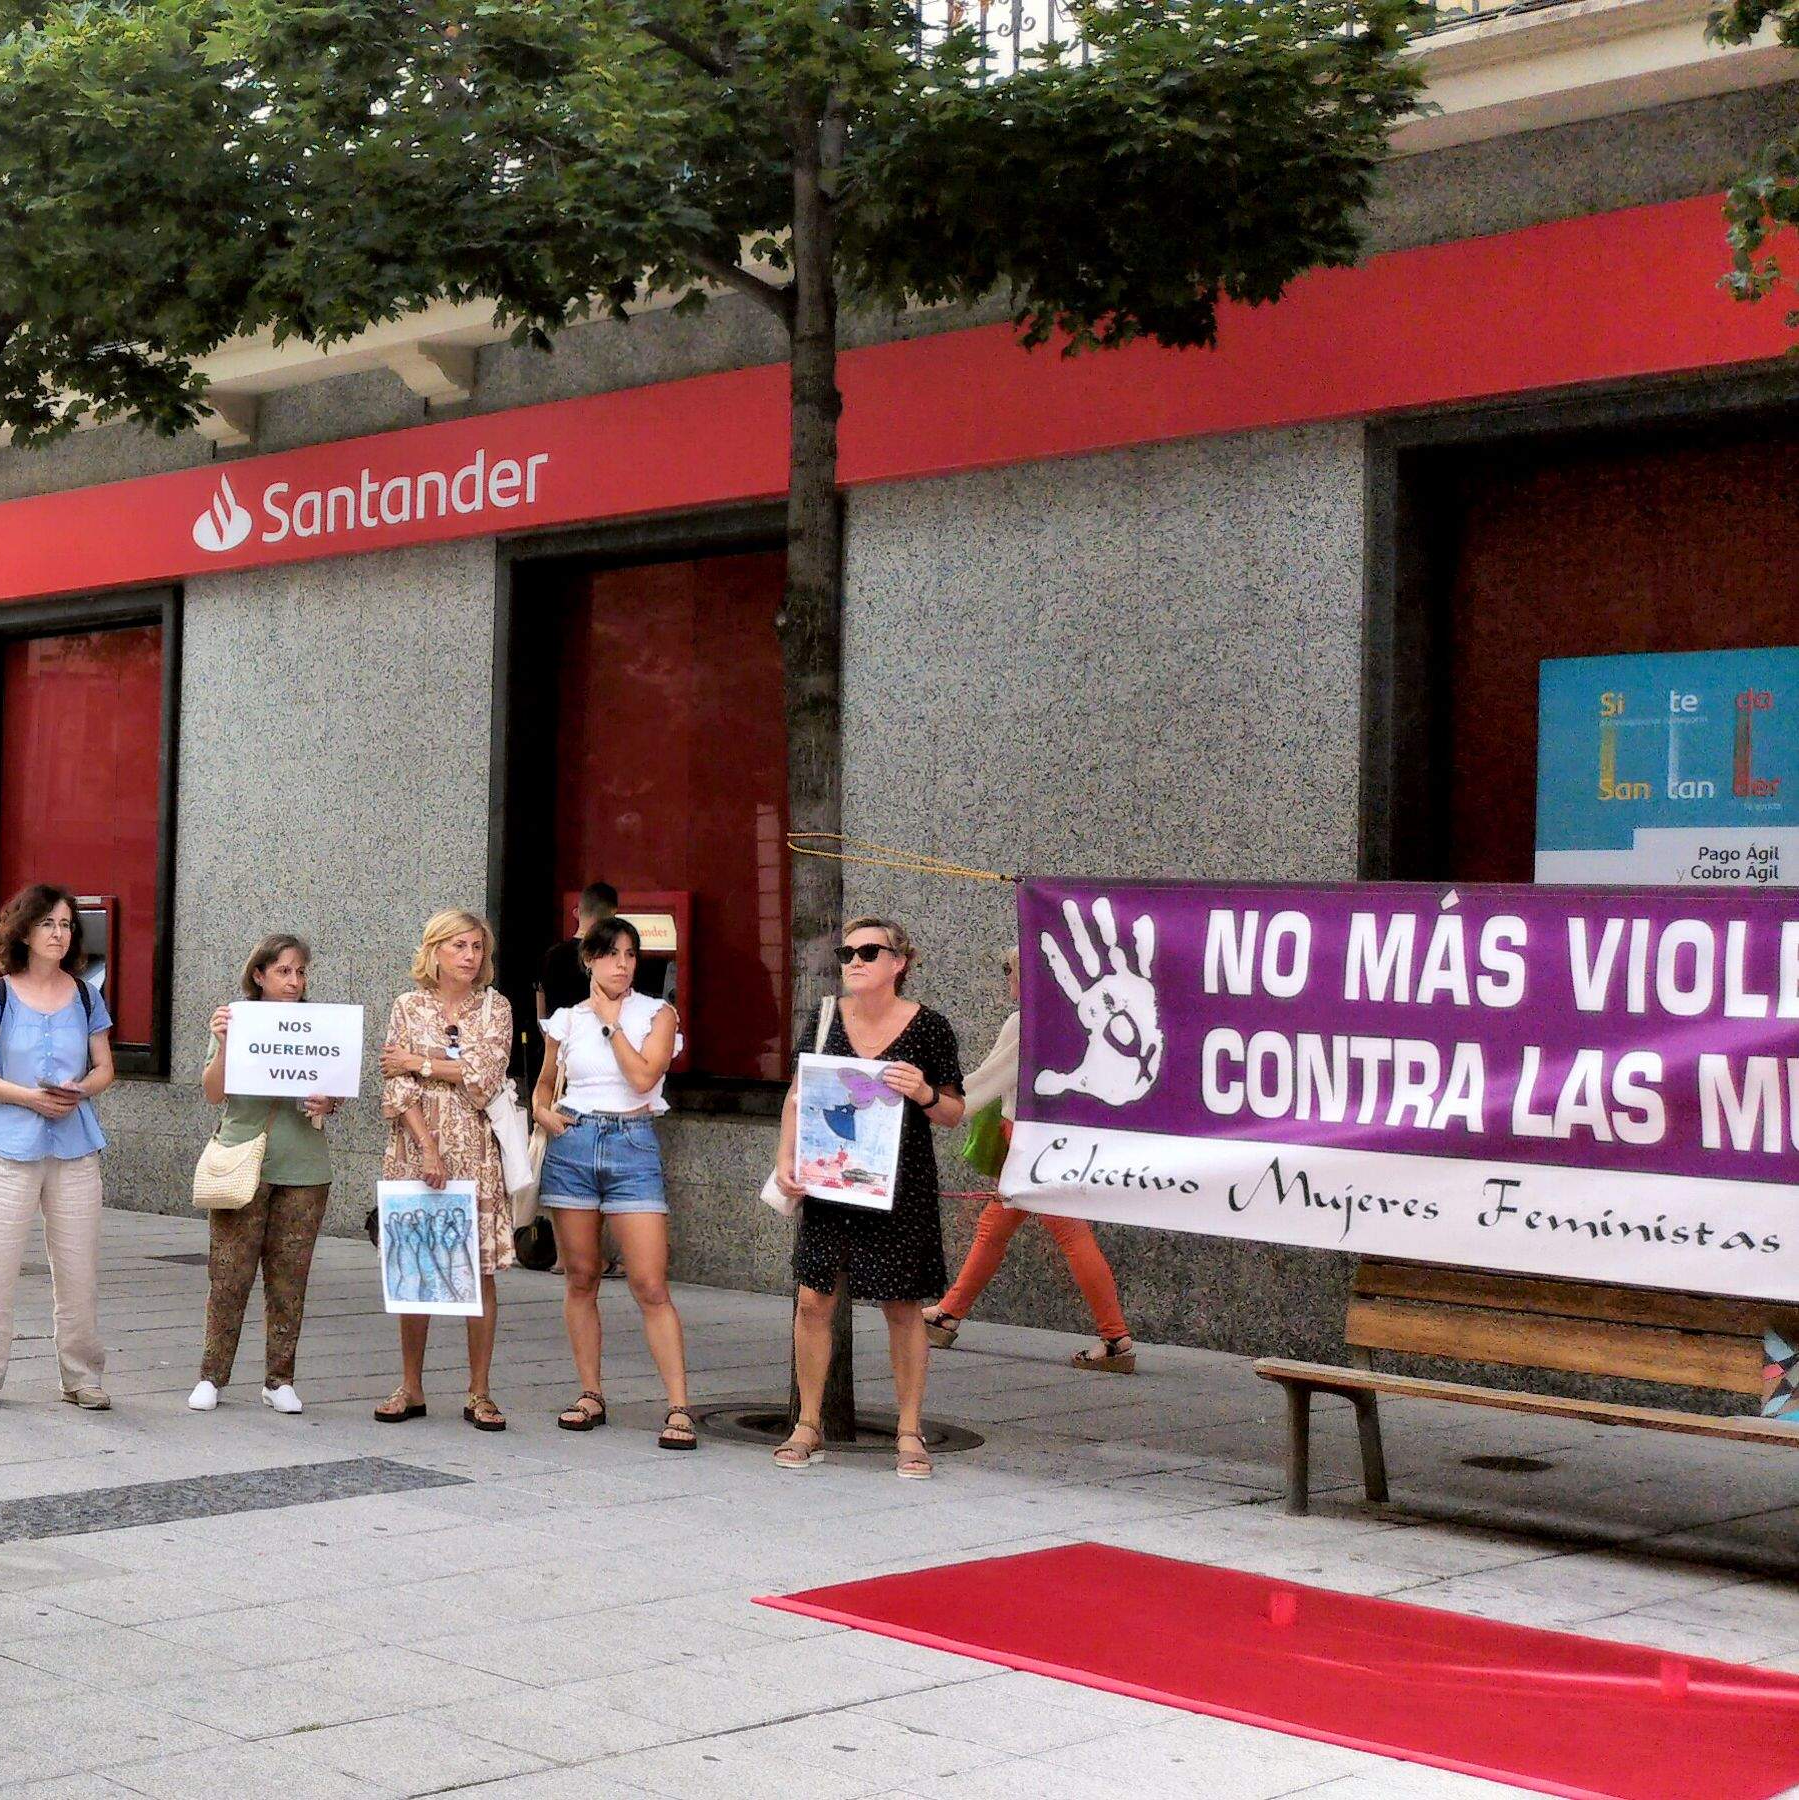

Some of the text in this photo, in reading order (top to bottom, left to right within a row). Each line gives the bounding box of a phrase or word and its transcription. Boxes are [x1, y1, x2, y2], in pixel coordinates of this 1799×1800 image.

[261, 448, 549, 543] Santander
[1669, 688, 1700, 714] te
[1736, 687, 1774, 713] da
[1597, 780, 1651, 801] San
[1666, 778, 1716, 800] tan
[1698, 842, 1780, 865] Pago Ágil
[1676, 861, 1780, 884] y Cobro Ágil
[1203, 909, 1312, 998] NO
[1344, 888, 1528, 1008] MÁS
[278, 1021, 312, 1033] NOS
[248, 1042, 341, 1057] QUEREMOS
[269, 1068, 318, 1081] VIVAS
[1200, 1026, 1799, 1155] CONTRA LAS M
[1029, 1137, 1781, 1254] Colectivo Mujeres Feministas
